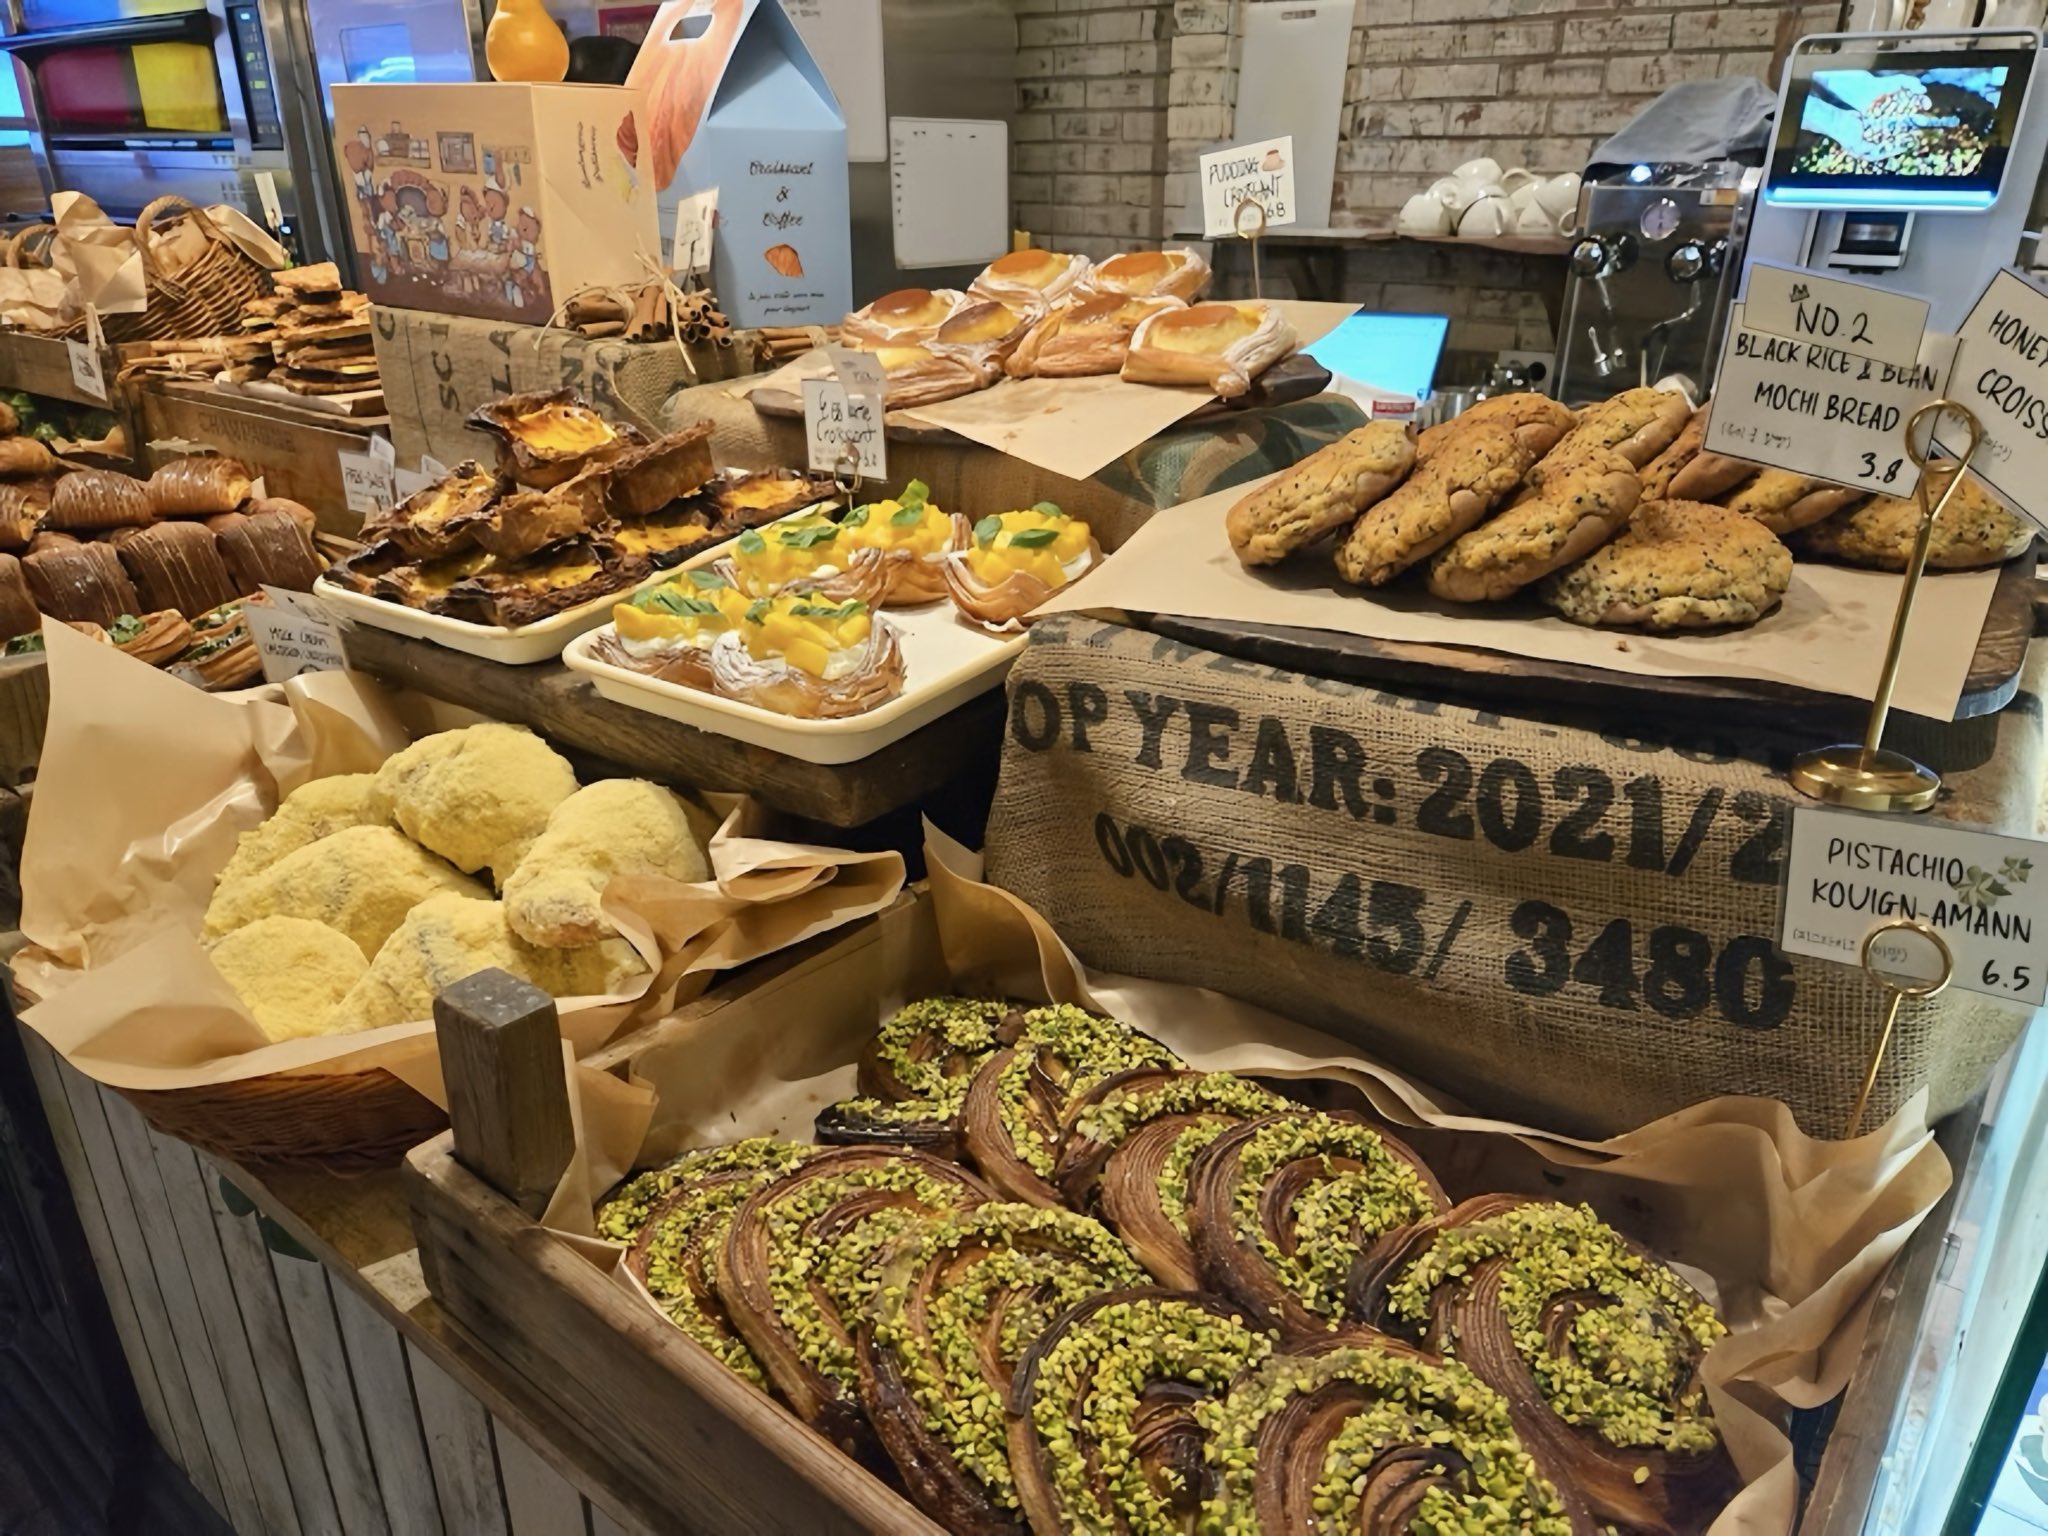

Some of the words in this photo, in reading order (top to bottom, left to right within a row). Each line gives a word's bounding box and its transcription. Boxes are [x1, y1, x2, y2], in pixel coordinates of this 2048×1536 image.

[776, 186, 790, 203] &
[1734, 333, 1801, 365] BLACK
[1806, 344, 1852, 374] RICE
[1754, 381, 1820, 417] MOCHI
[1822, 394, 1901, 433] BREAD
[1857, 452, 1904, 484] 3.8
[1124, 690, 1397, 825] YEAR:
[1828, 838, 1964, 887] PISTACHIO
[1505, 900, 1797, 1031] 3480
[1981, 959, 2031, 992] 6.5
